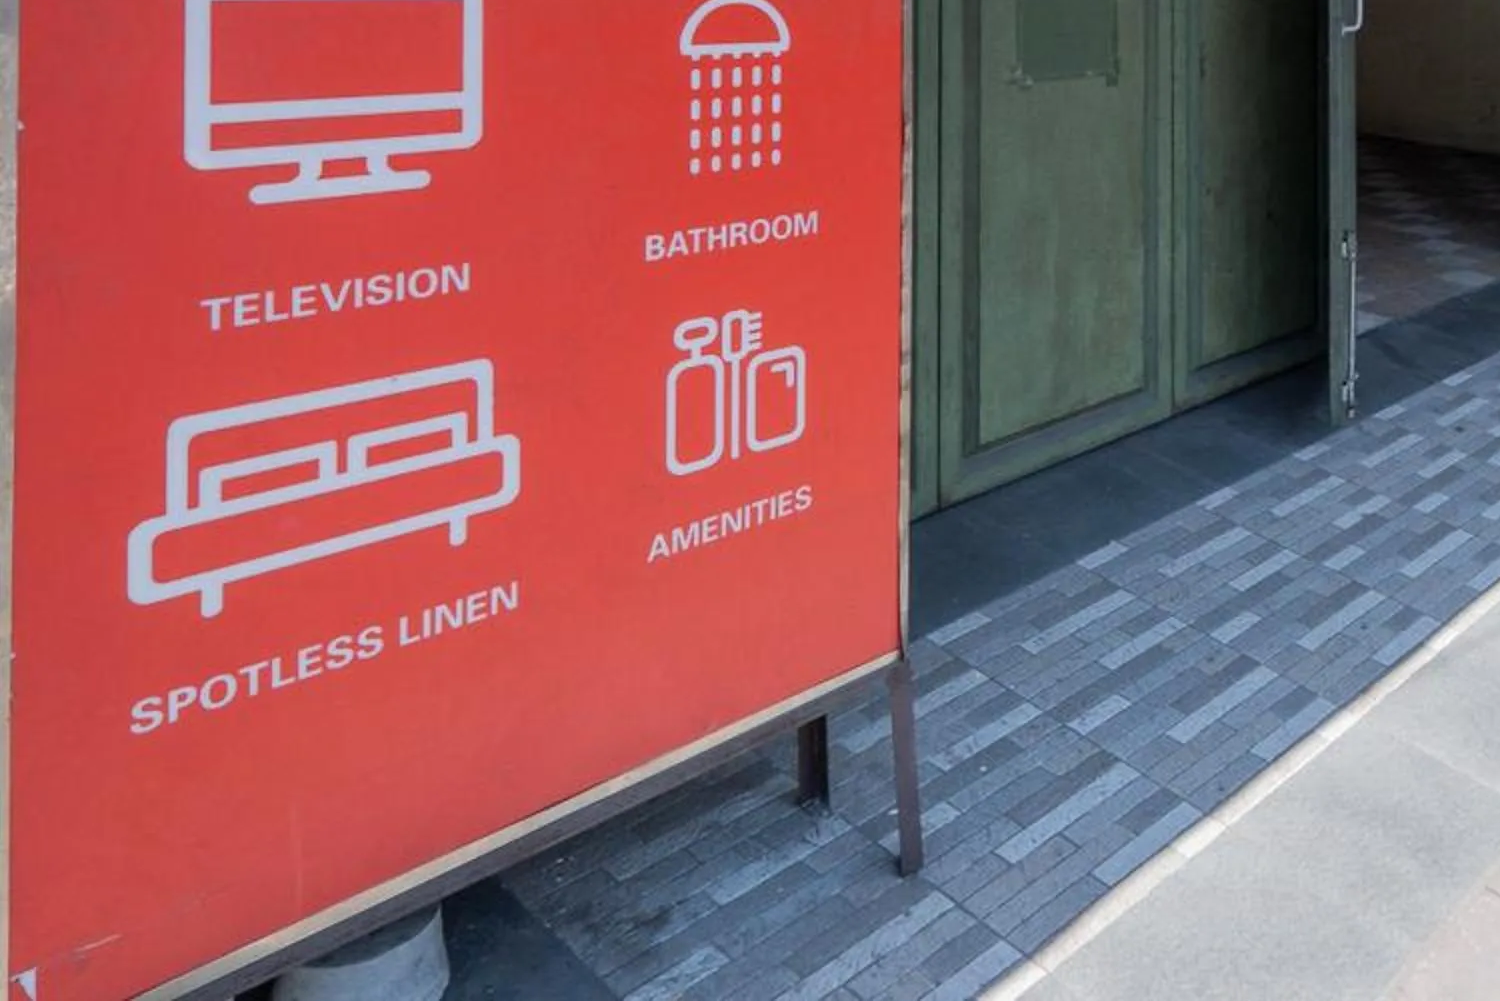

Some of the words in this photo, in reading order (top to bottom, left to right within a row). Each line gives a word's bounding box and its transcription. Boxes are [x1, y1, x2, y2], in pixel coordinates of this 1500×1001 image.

[644, 210, 819, 262] BATHROOM
[200, 262, 471, 331] TELEVISION
[647, 485, 813, 563] AMENITIES
[130, 625, 385, 735] SPOTLESS
[399, 581, 519, 646] LINEN
